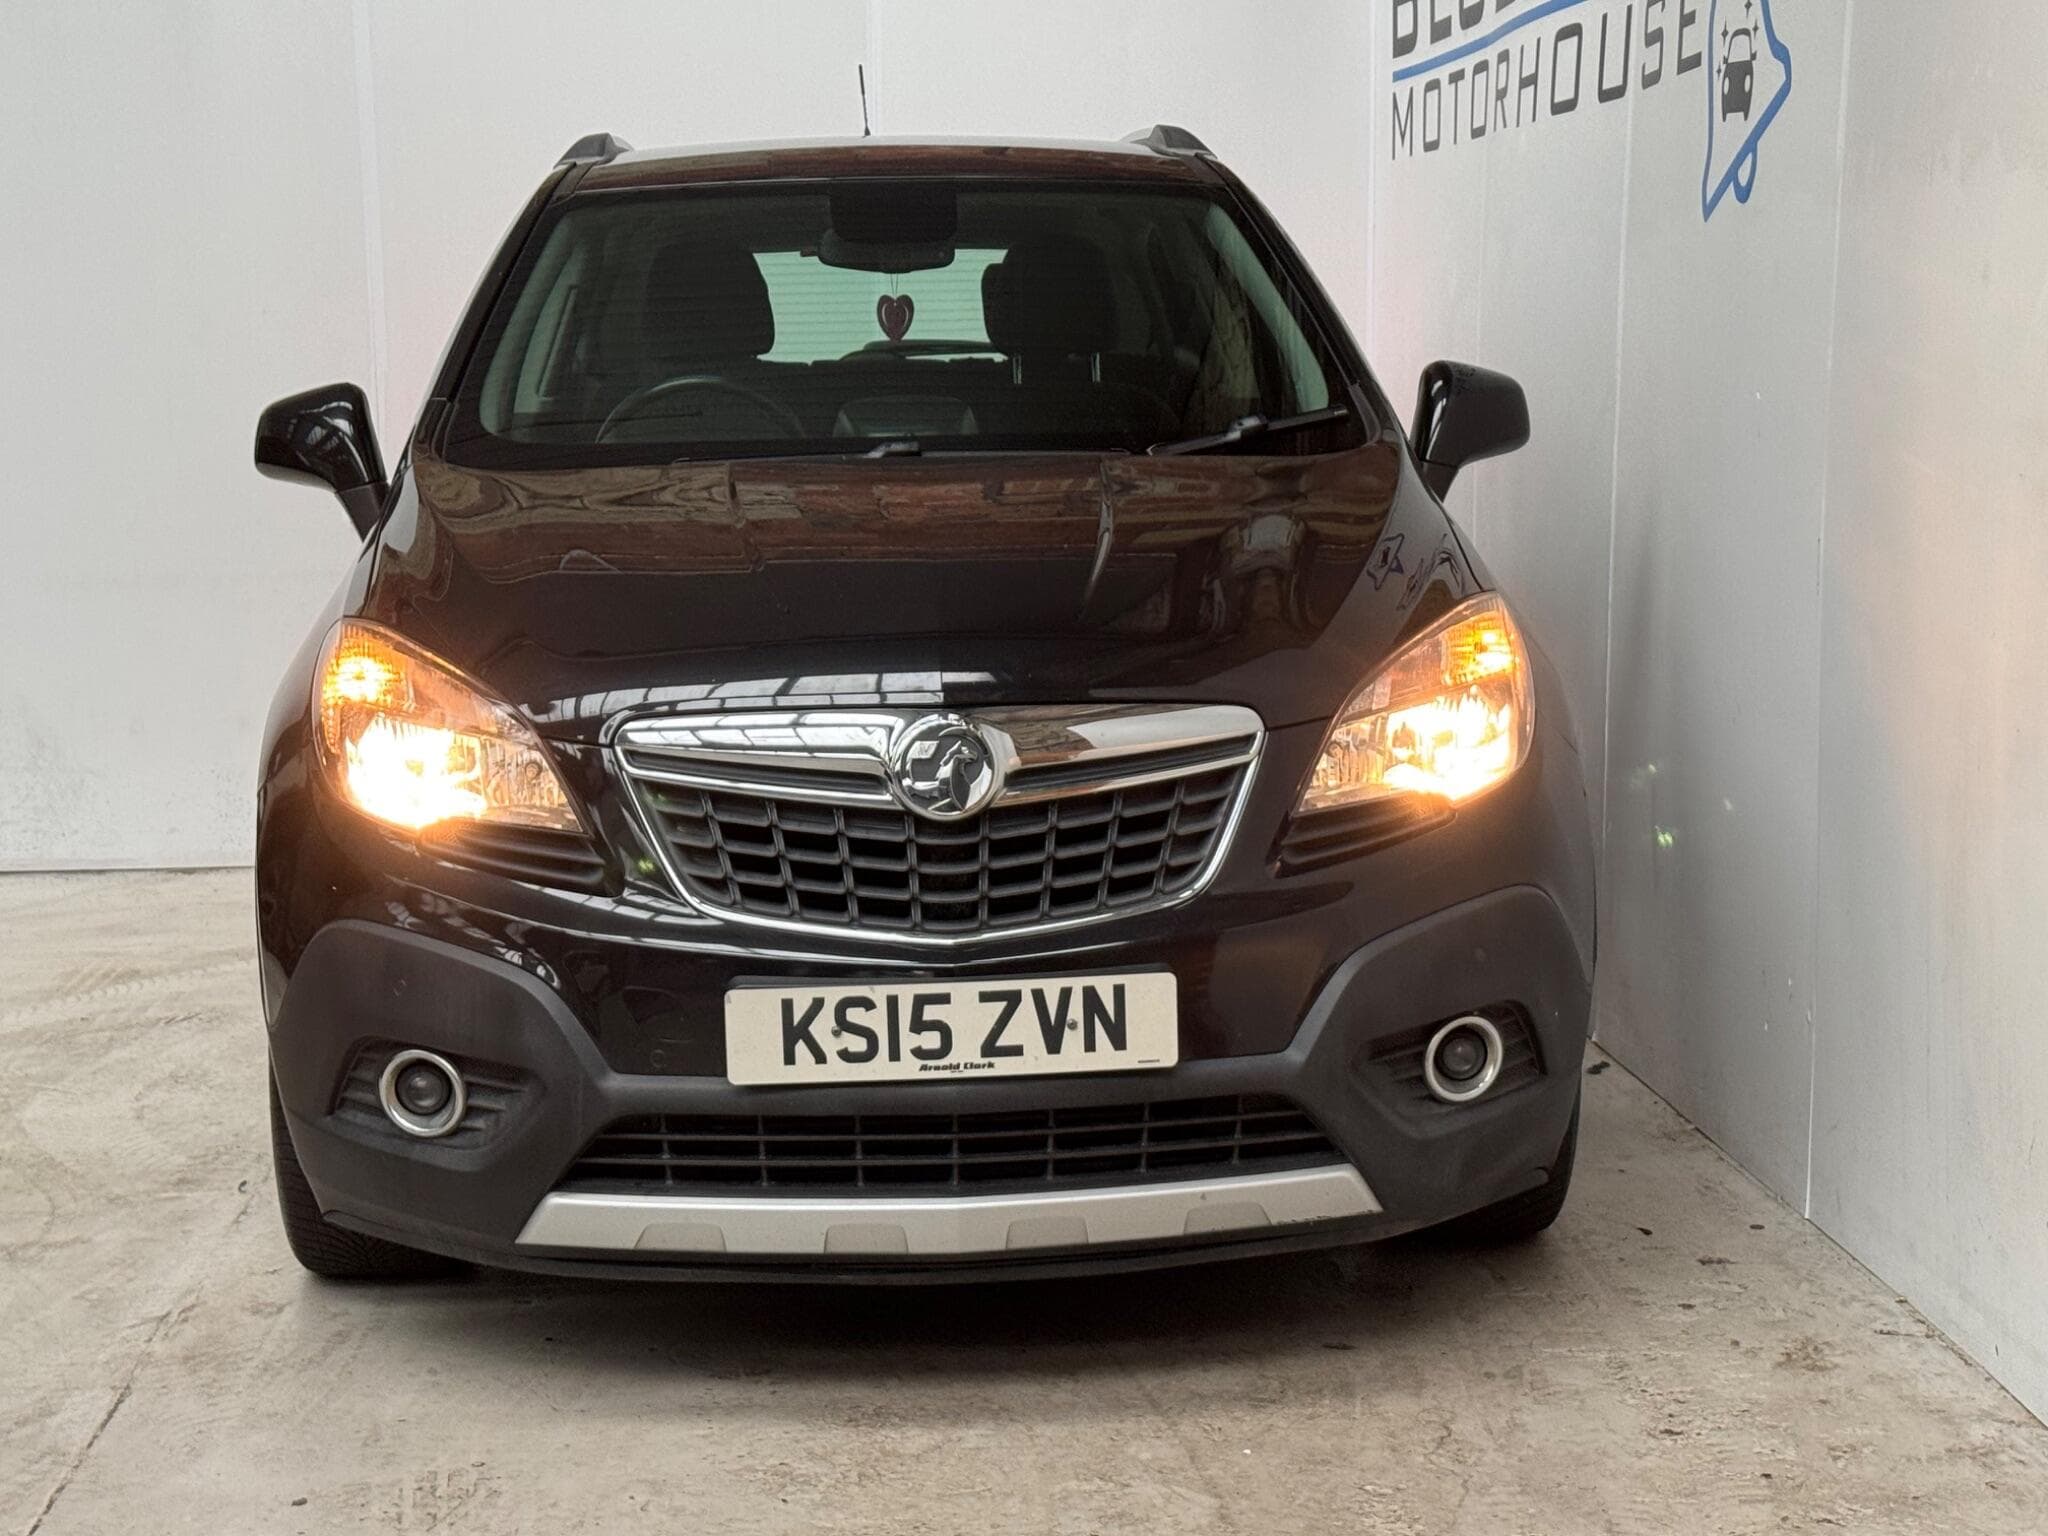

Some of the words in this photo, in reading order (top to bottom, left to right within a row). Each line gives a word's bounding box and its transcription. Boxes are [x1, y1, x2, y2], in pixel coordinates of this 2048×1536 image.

[1392, 0, 1702, 160] MOTORHOUSE
[781, 992, 953, 1066] KS15
[978, 983, 1127, 1058] ZVN
[919, 1063, 960, 1072] Arnold
[963, 1061, 995, 1070] Clark
